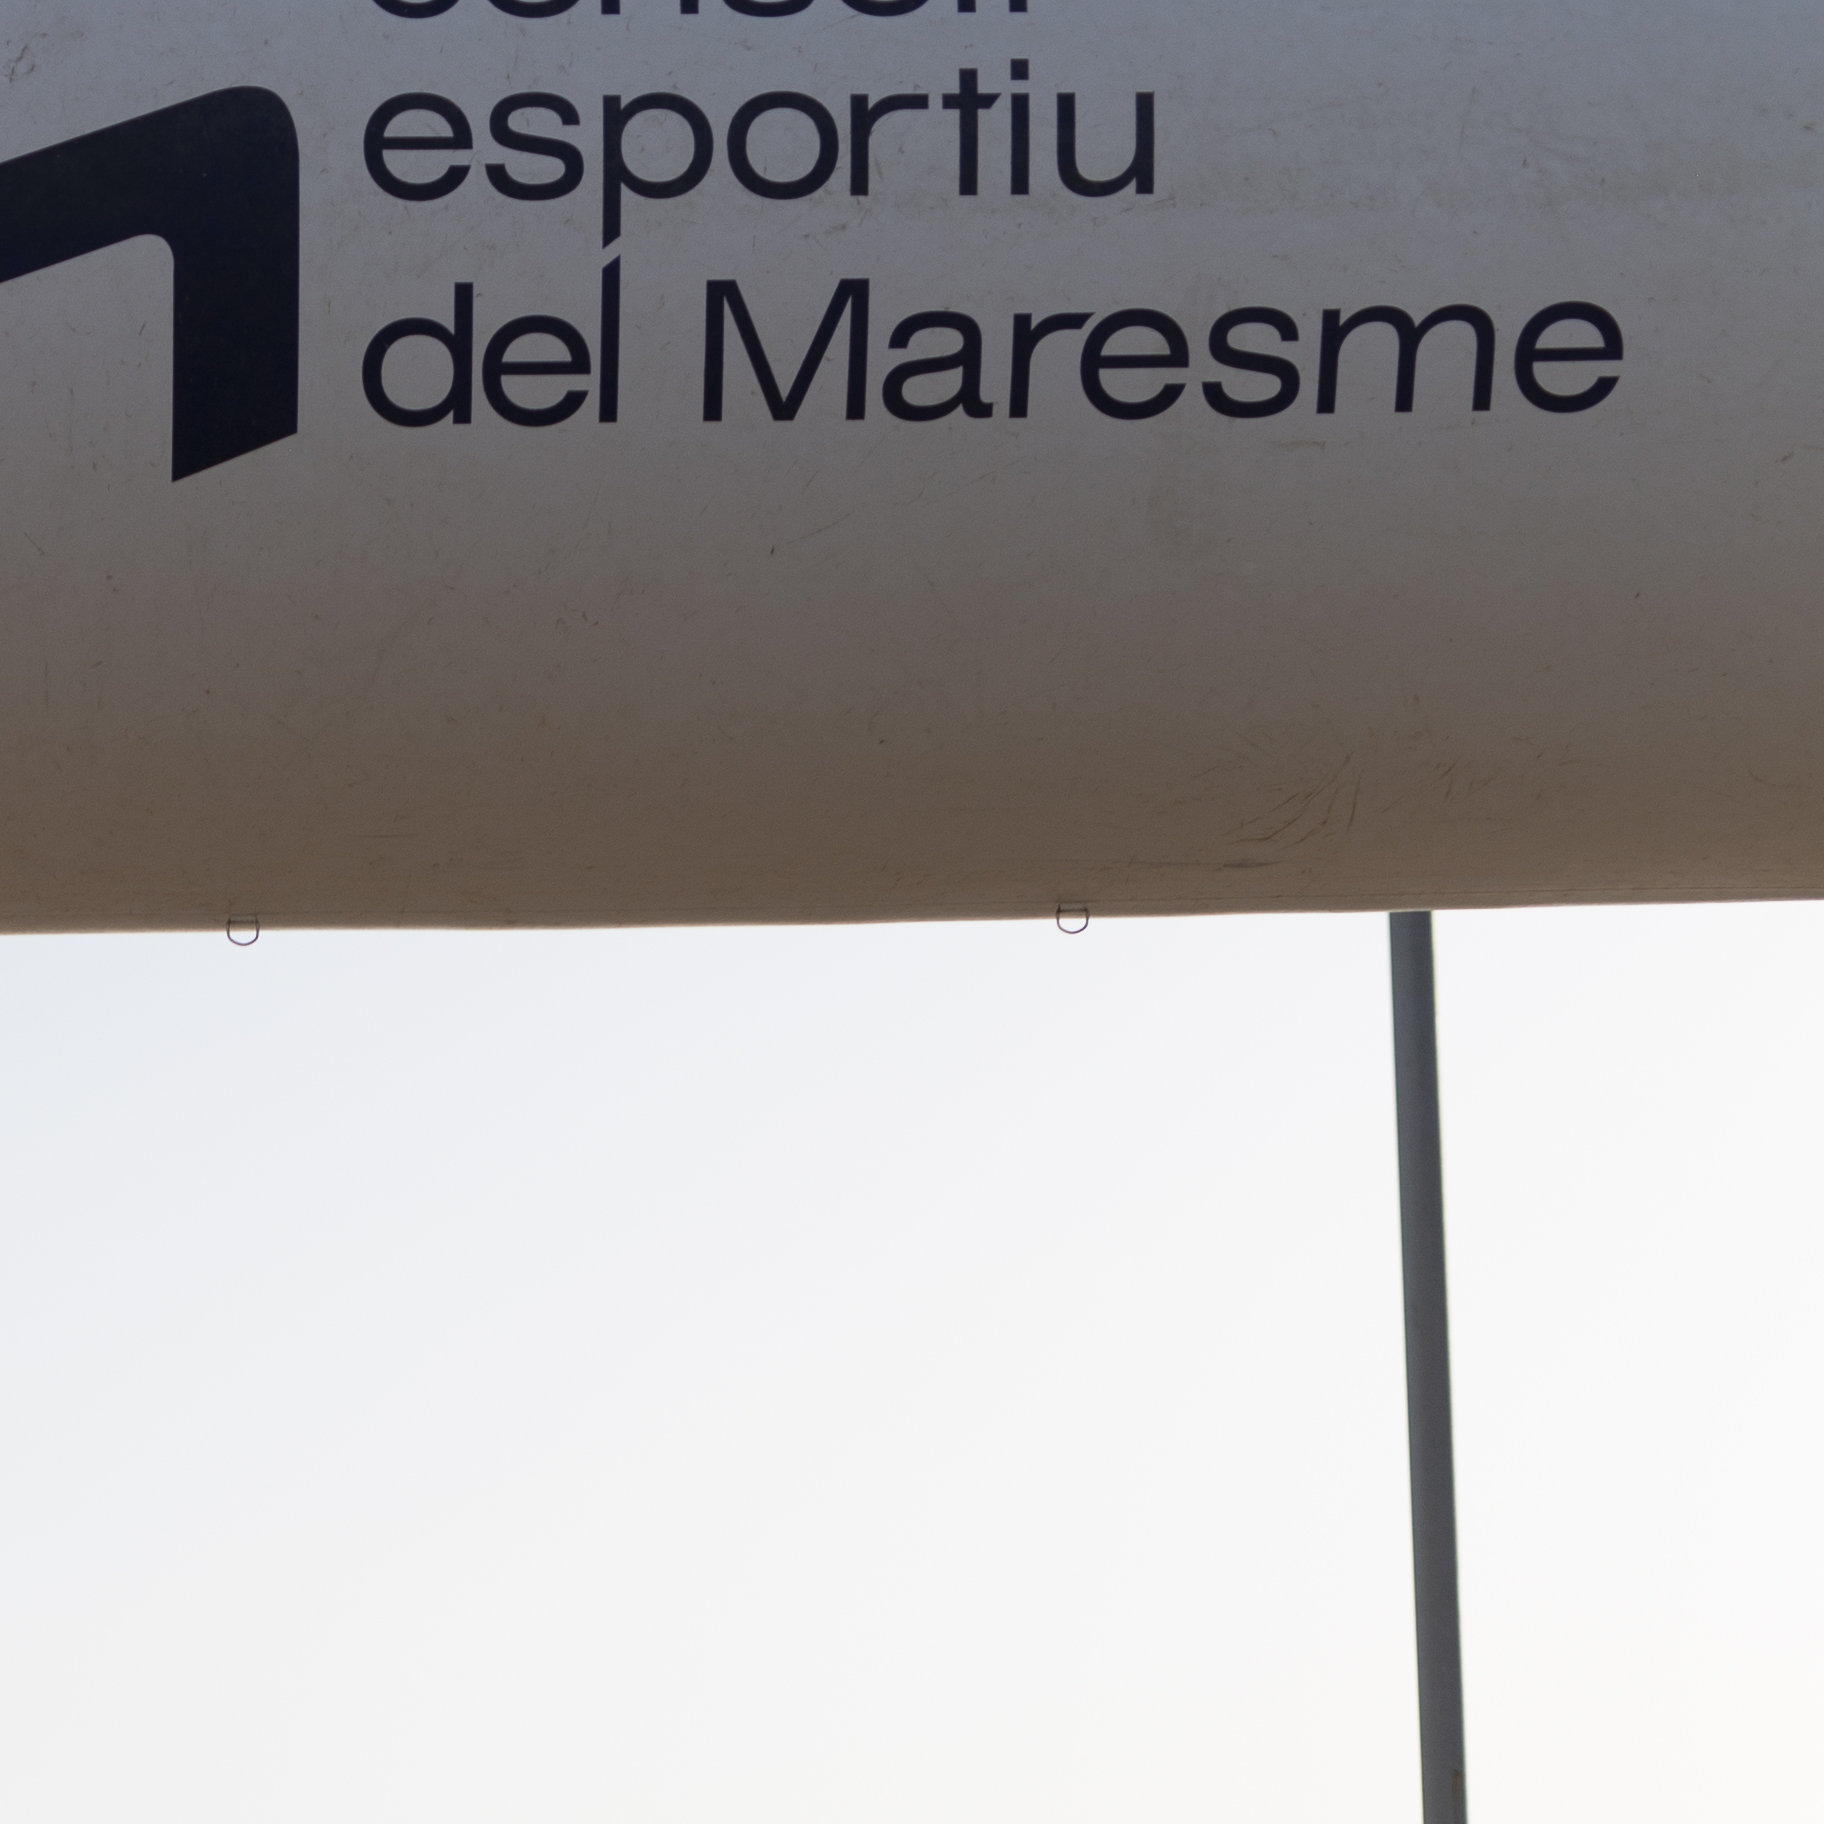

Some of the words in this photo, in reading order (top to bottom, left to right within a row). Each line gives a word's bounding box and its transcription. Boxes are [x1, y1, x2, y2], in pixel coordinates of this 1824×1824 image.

[363, 58, 1156, 251] esportiu
[361, 253, 621, 427] del
[702, 277, 1625, 423] Maresme
